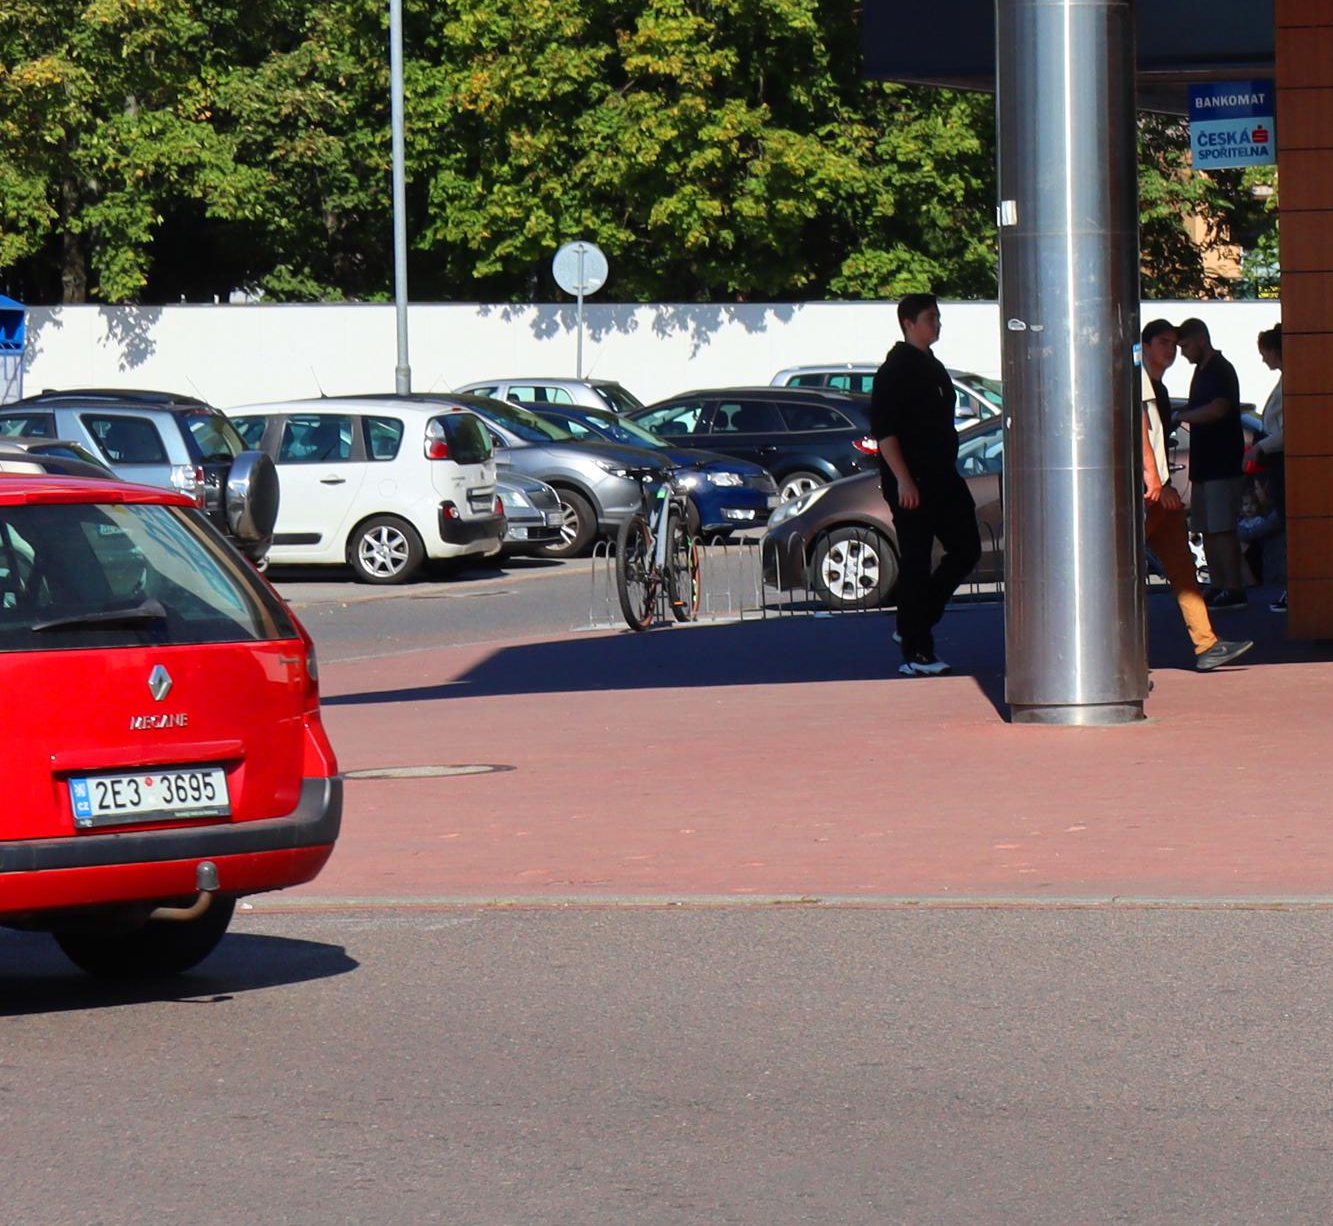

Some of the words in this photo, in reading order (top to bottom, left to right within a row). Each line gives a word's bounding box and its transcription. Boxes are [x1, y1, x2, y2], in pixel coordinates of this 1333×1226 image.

[1195, 94, 1265, 109] BANKOMAT
[1197, 127, 1251, 147] ČESKÁ
[1198, 145, 1269, 160] SPOŘITELNA
[129, 713, 188, 730] MEGANE
[95, 779, 141, 809] 2E3
[160, 774, 216, 804] 3695
